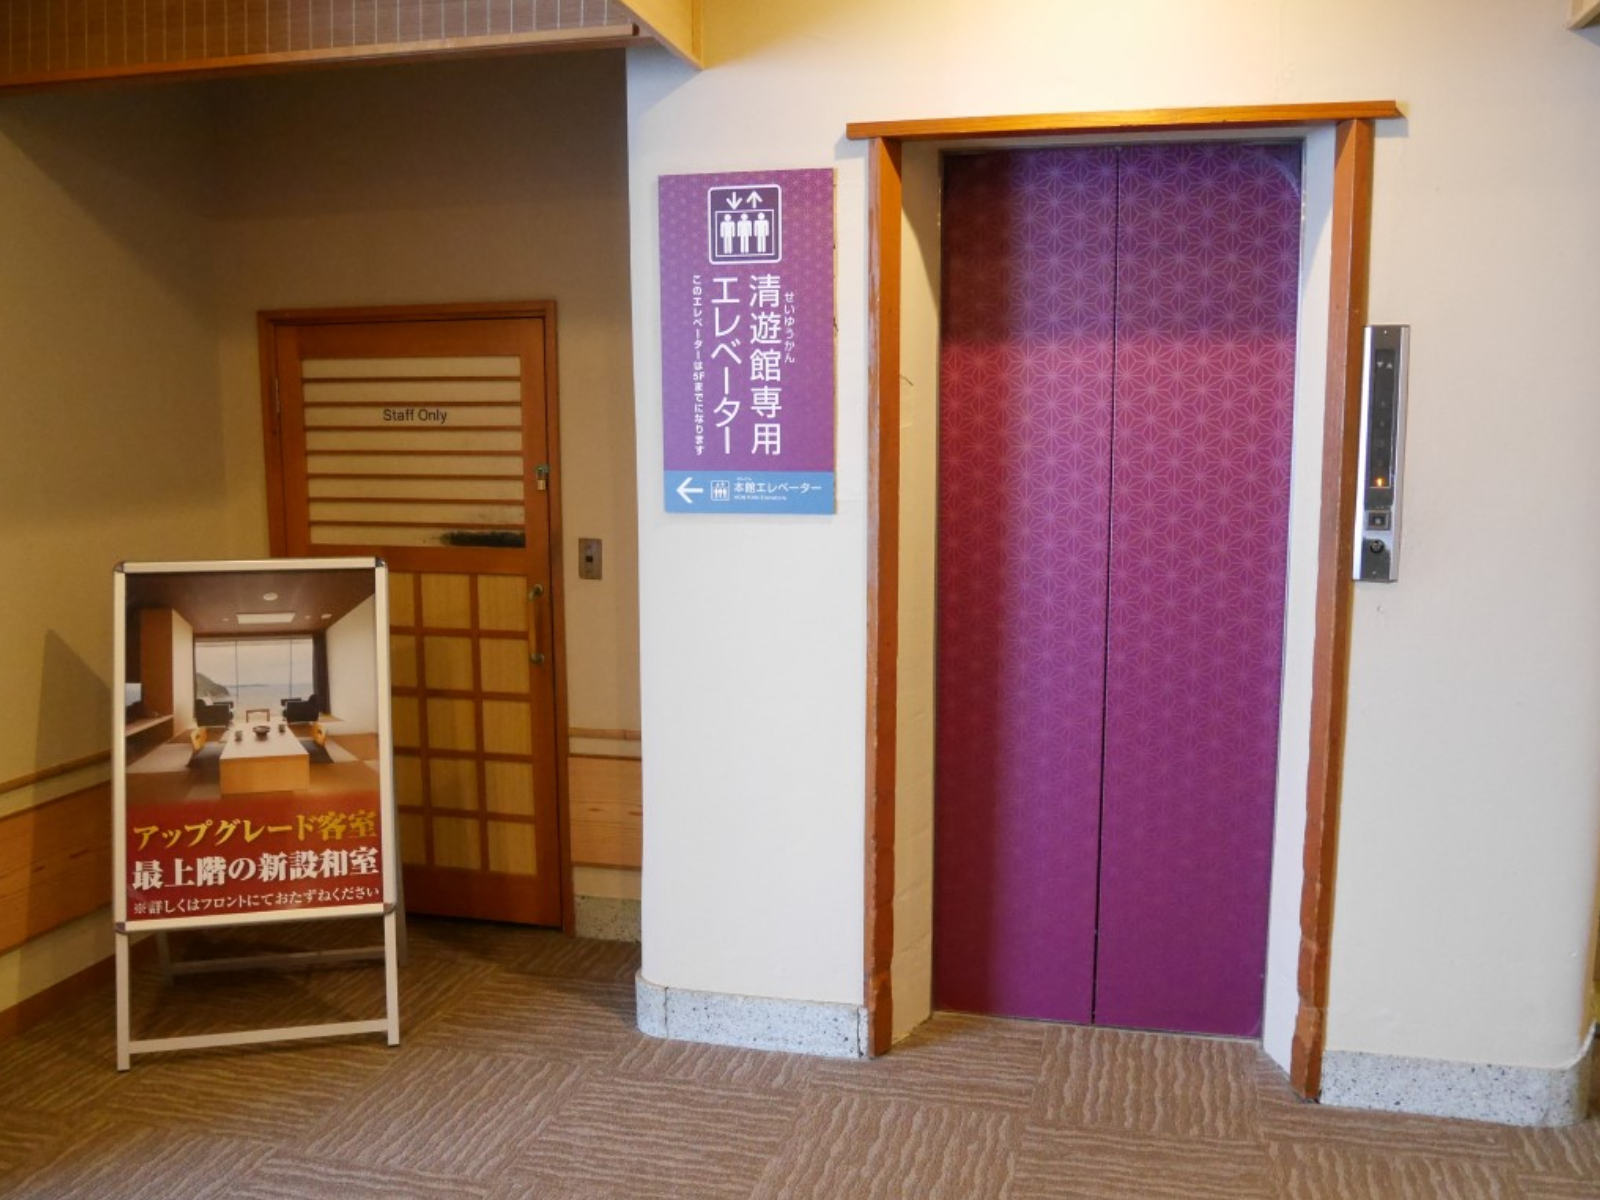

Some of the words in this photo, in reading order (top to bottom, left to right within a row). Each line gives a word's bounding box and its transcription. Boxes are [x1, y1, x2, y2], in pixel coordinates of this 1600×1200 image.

[784, 291, 795, 363] せいゆうかん
[711, 277, 742, 454] エレベーター
[749, 273, 782, 455] 清遊館専用
[383, 409, 414, 421] Staff
[418, 409, 447, 424] Only
[733, 482, 822, 494] 本館エレベーター
[133, 809, 378, 851] アップグレード客室
[132, 846, 380, 891] 最上階の新設和室
